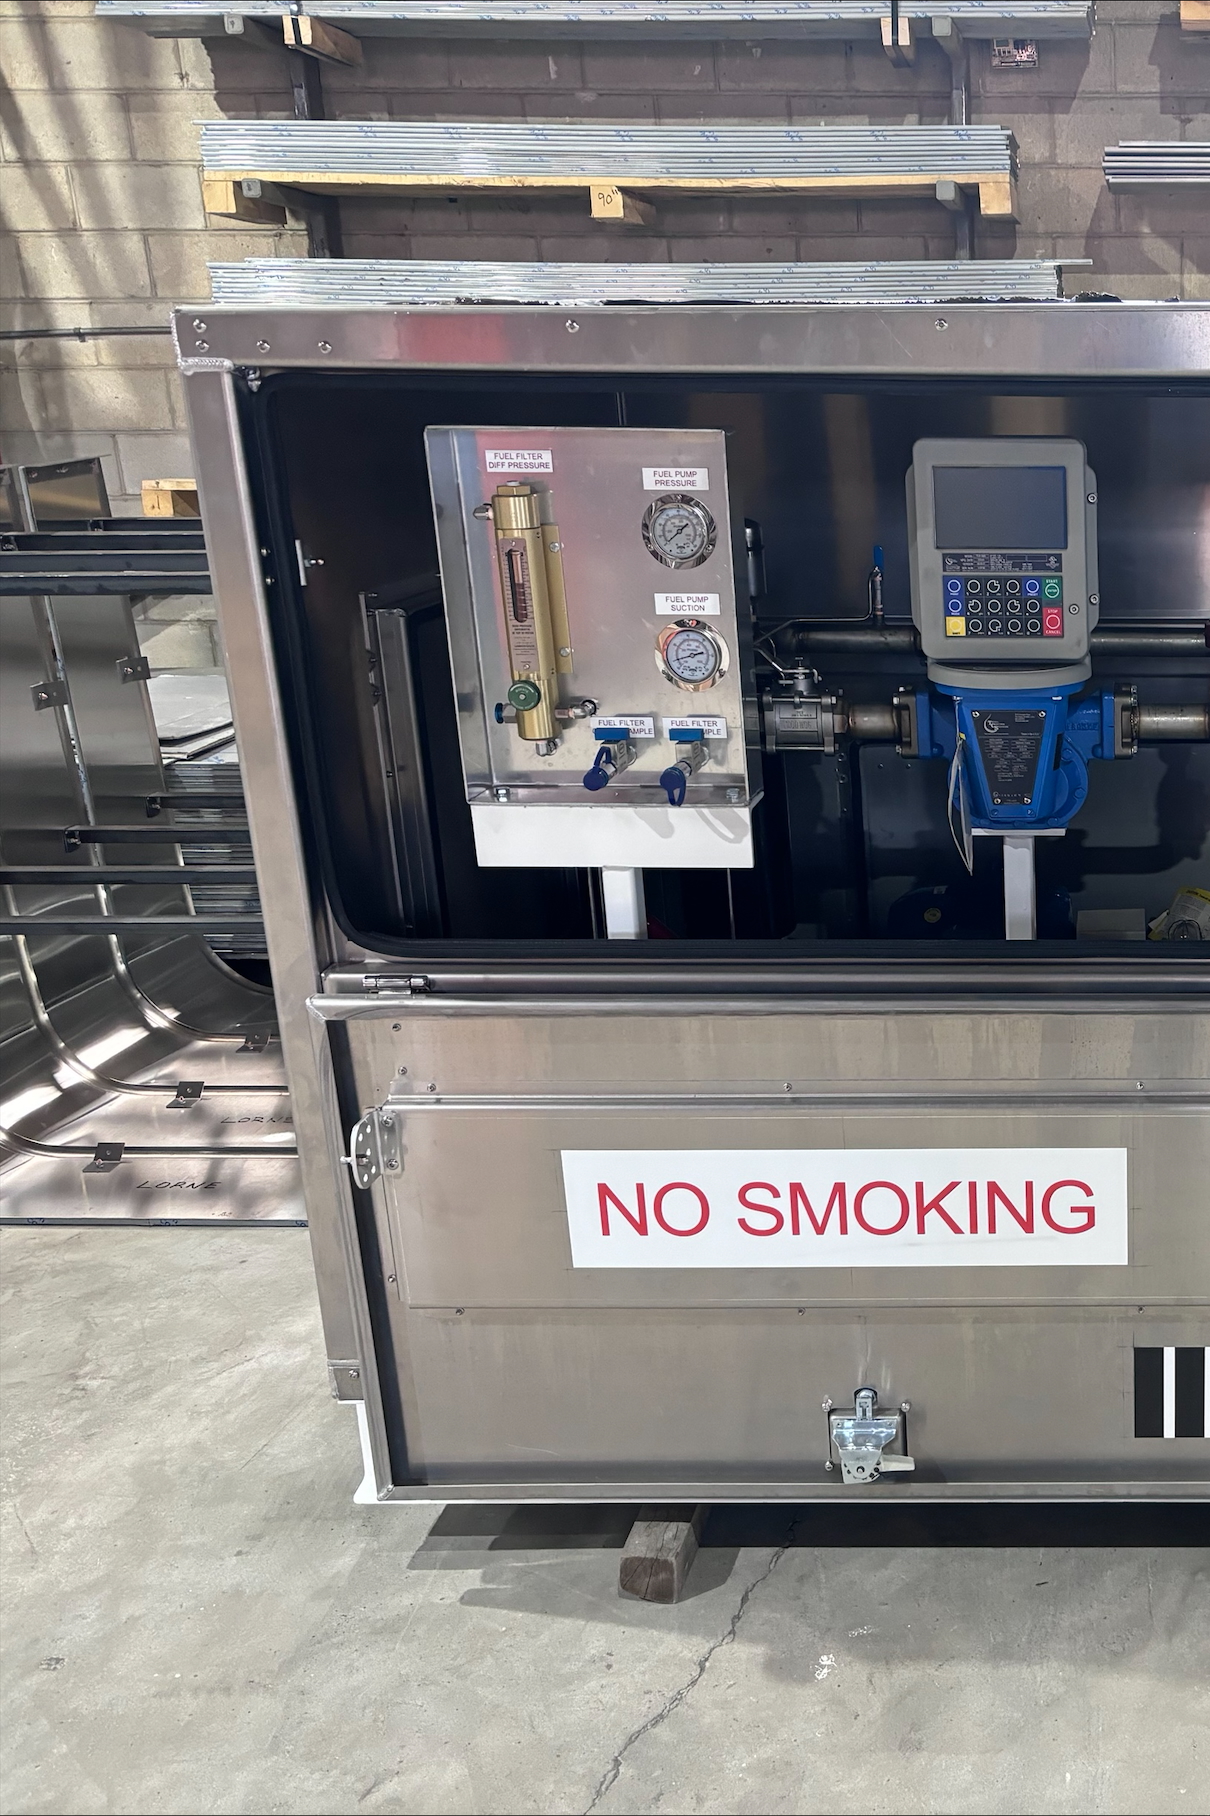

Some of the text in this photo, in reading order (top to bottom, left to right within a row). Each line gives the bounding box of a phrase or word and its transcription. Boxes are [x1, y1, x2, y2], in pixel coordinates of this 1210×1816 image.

[494, 452, 543, 460] FUEL FILTER
[489, 461, 550, 469] DIFF PRESSURE
[136, 1180, 222, 1190] LORNE
[597, 1179, 1096, 1238] NO SMOKING
